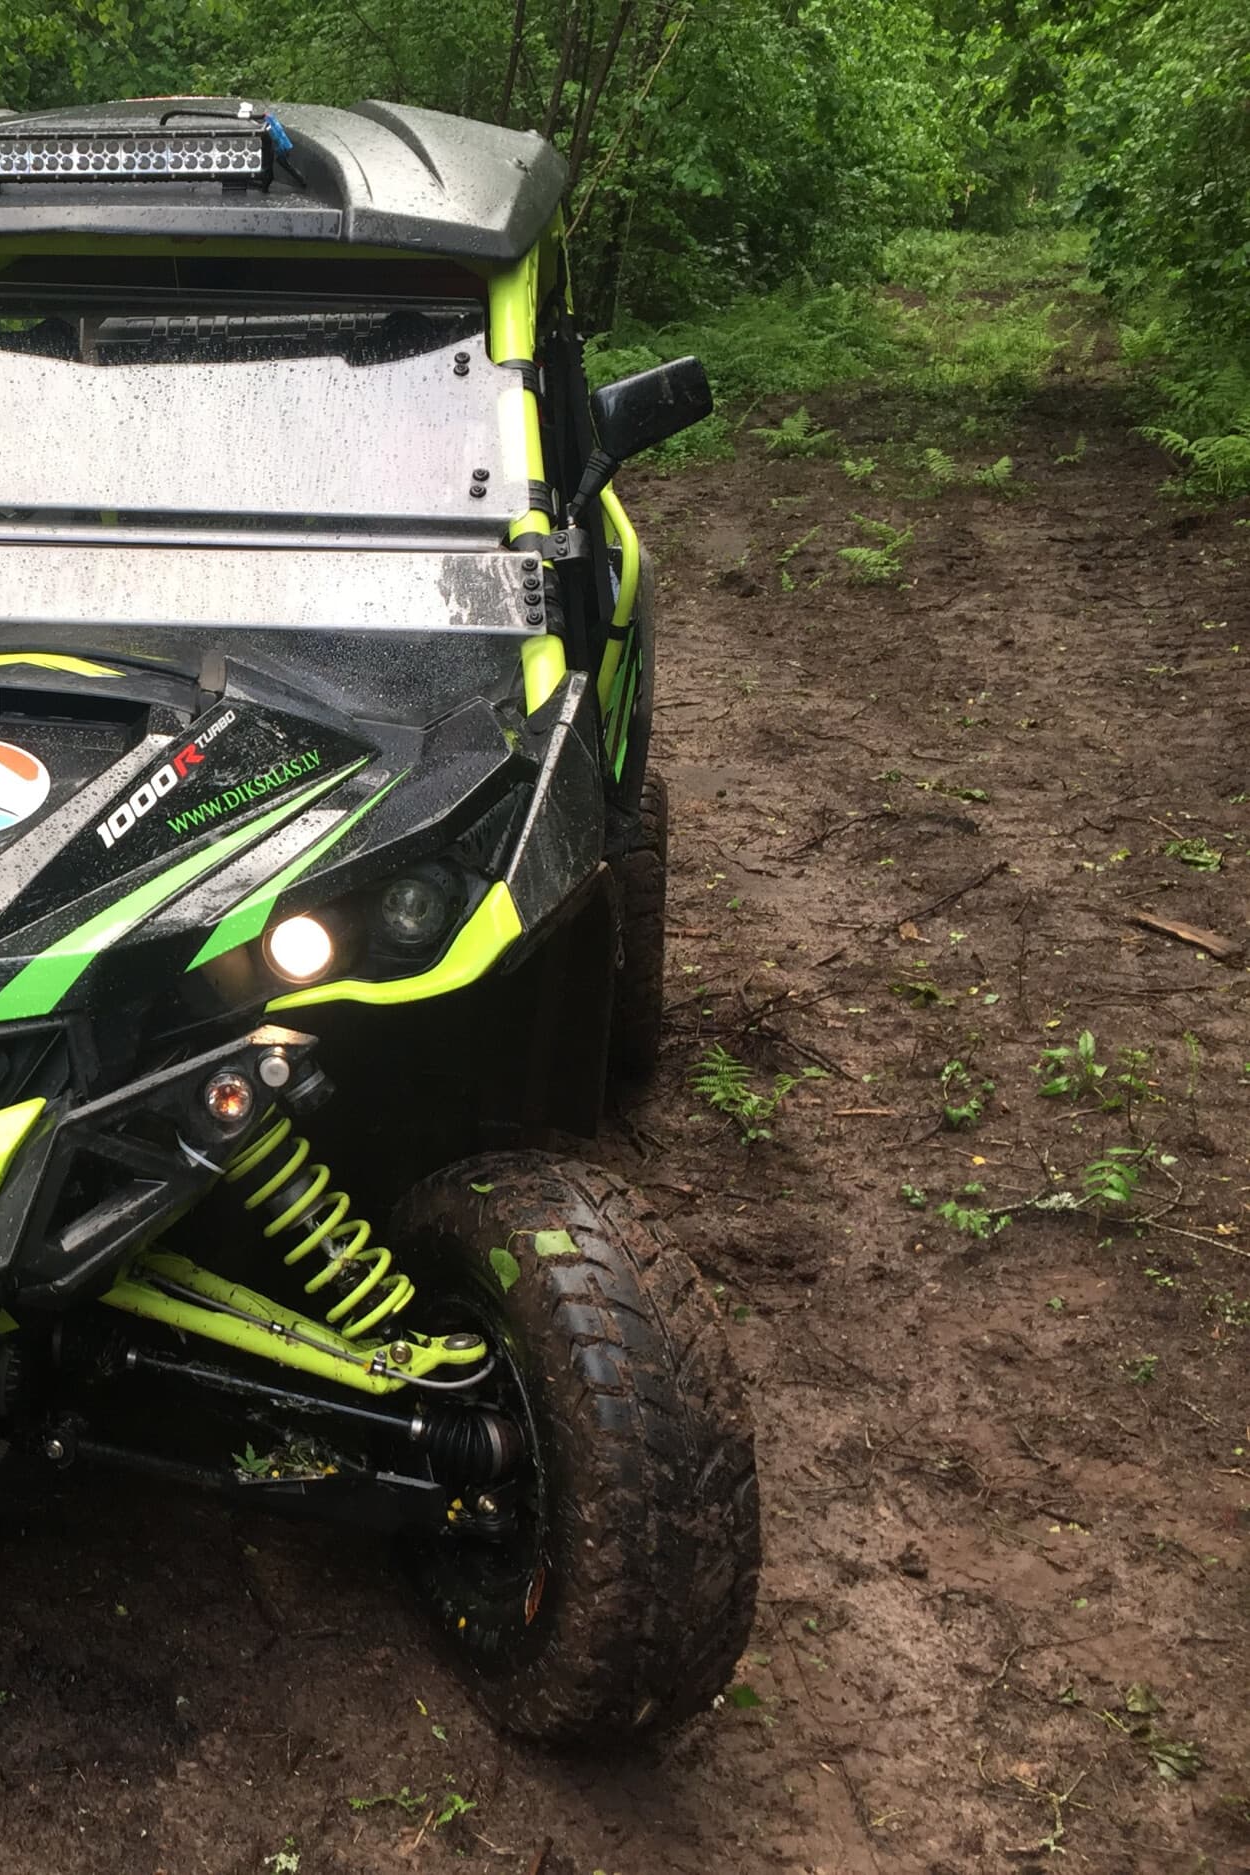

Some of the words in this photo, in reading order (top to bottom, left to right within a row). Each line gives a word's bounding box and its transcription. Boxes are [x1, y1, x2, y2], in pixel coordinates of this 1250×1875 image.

[96, 744, 205, 848] 1000R
[194, 710, 236, 748] TURBO
[166, 749, 321, 834] WWW.DIKSALAS.LV
